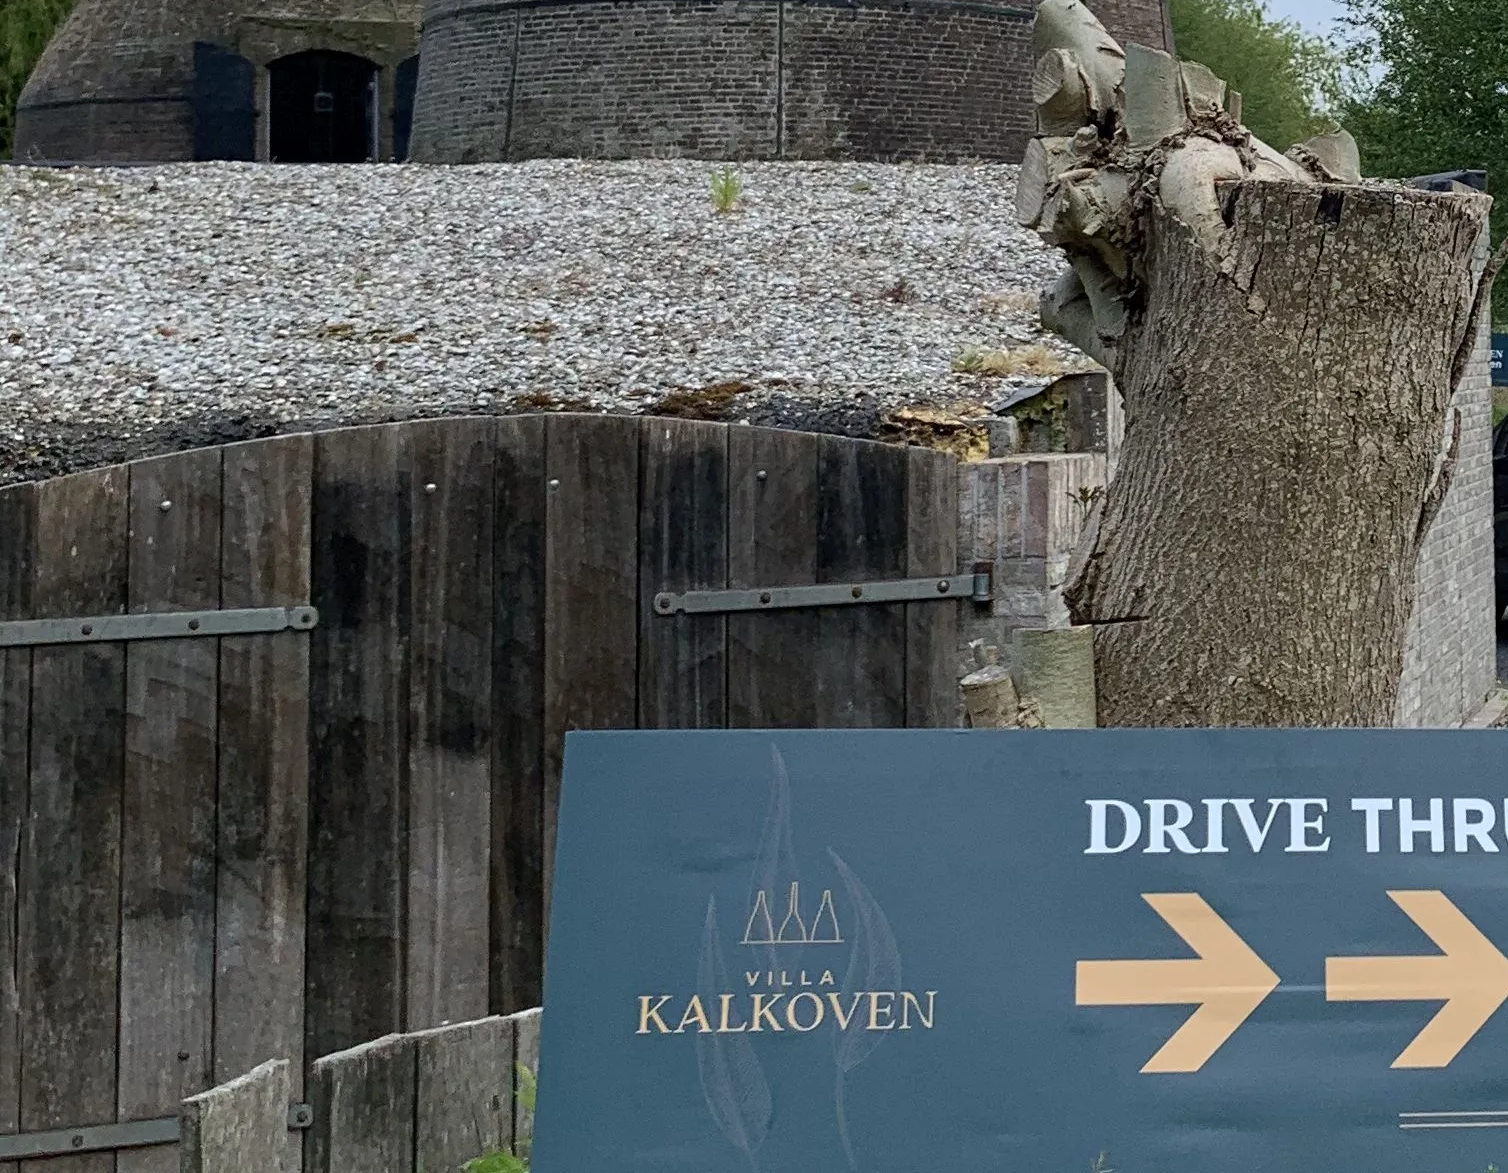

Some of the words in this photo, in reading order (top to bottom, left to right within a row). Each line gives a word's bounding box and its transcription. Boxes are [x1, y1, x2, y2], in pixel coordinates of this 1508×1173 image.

[1083, 797, 1331, 854] DRIVE
[745, 969, 835, 986] VILLA
[635, 990, 939, 1034] KALKOVEN
